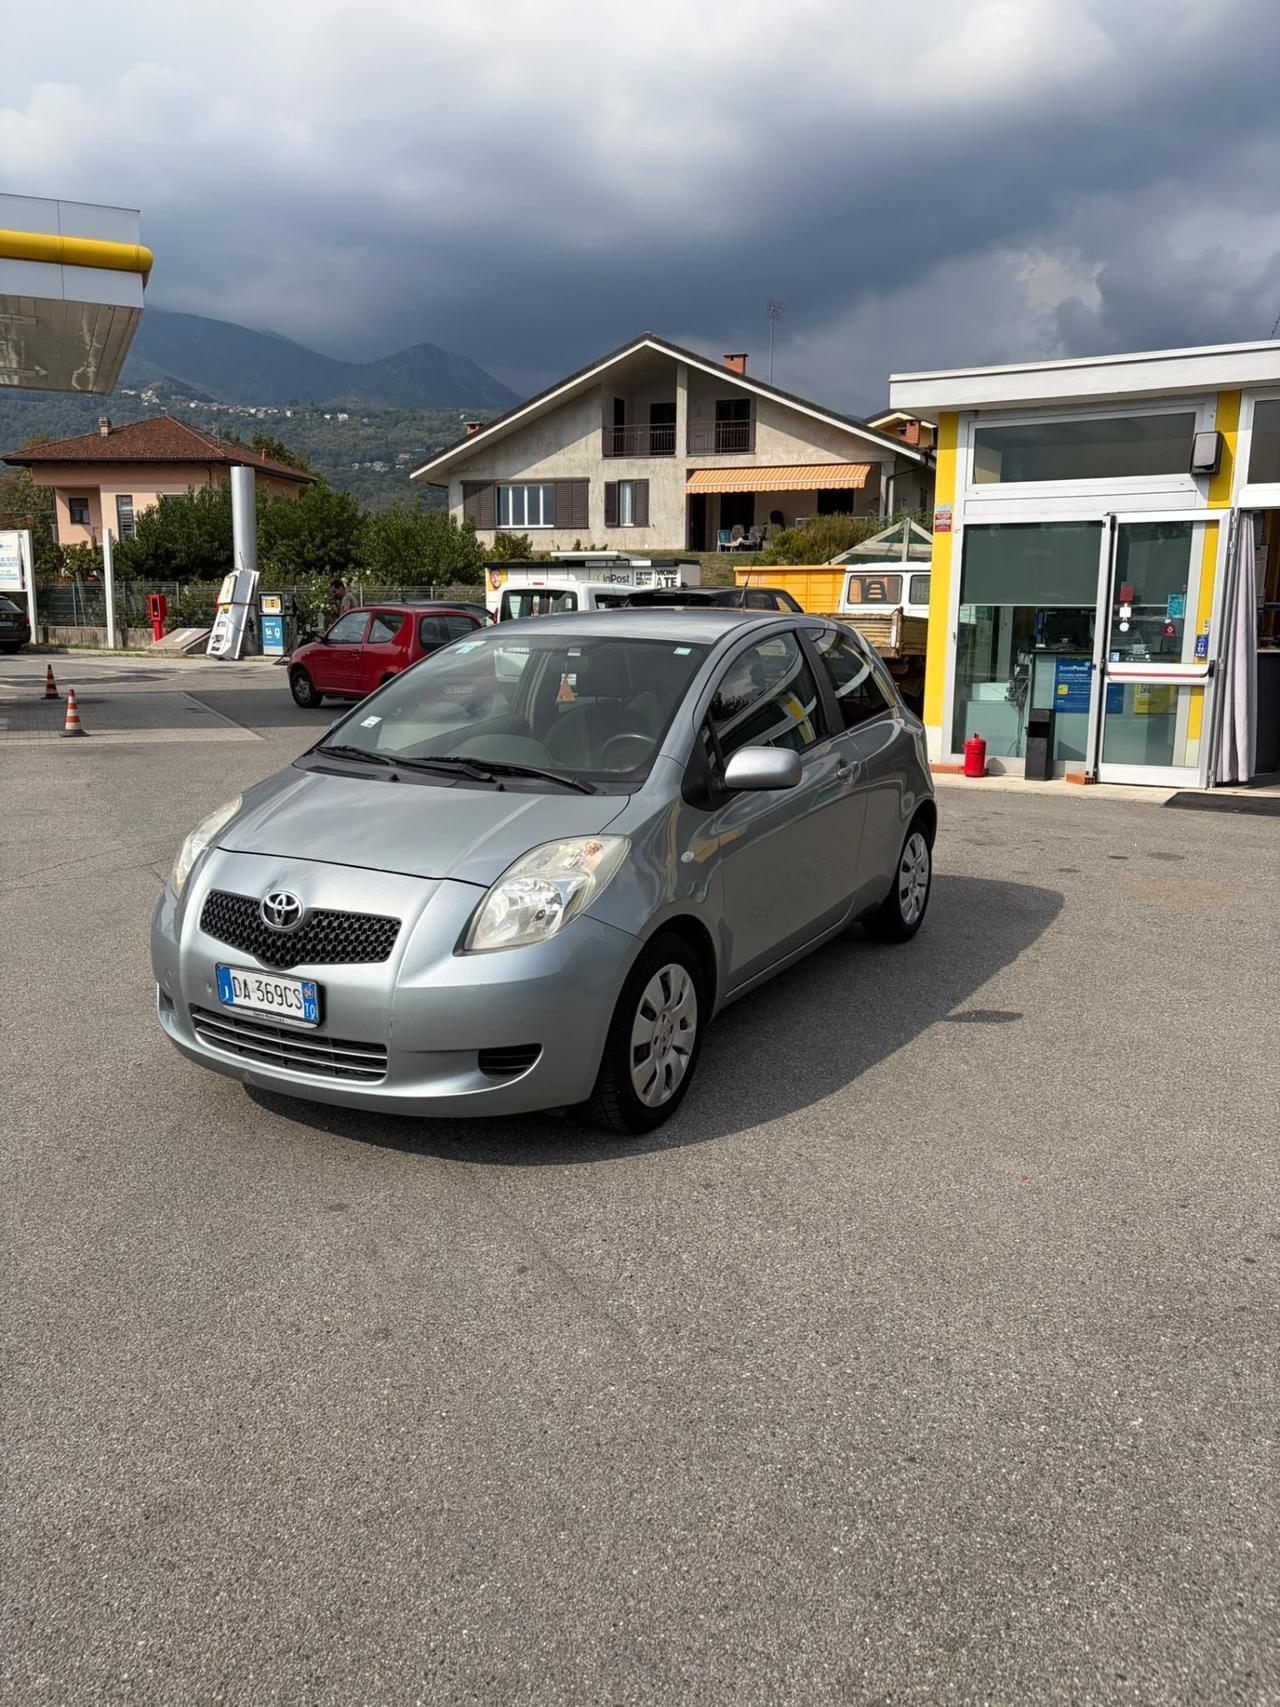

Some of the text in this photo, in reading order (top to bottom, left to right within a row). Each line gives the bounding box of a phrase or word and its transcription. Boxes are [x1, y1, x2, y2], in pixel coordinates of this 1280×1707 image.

[602, 574, 630, 584] InPost
[664, 577, 677, 588] TE
[232, 976, 303, 1010] DA 369CS
